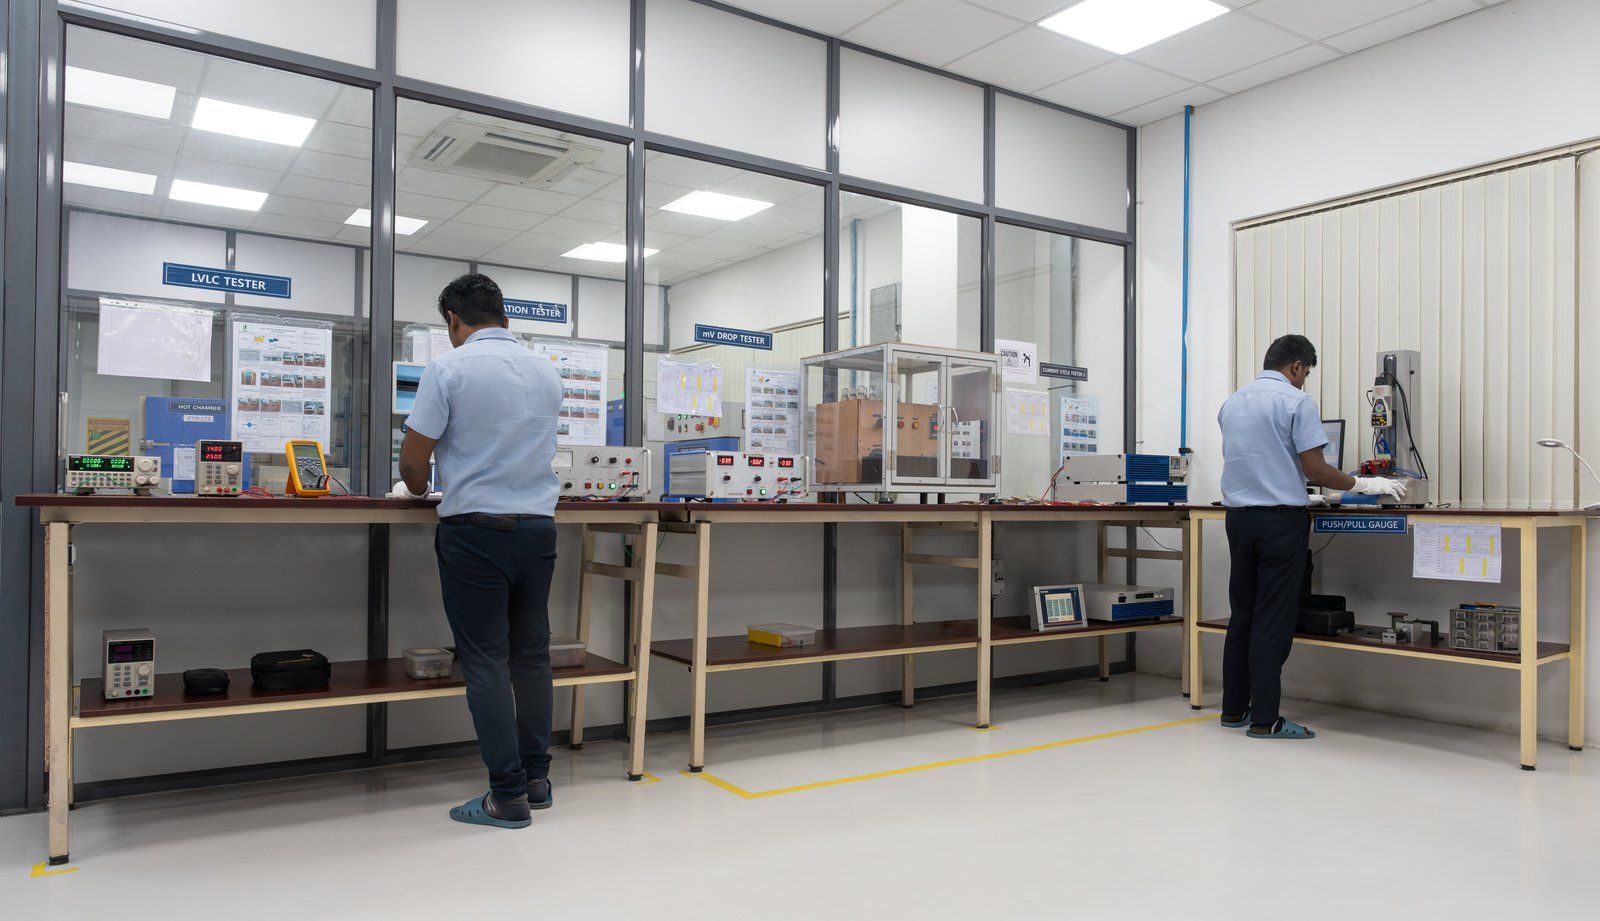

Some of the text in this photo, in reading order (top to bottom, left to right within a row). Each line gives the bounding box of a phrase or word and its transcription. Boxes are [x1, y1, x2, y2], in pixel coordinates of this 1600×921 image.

[191, 272, 266, 290] LVLC TESTER
[531, 307, 561, 318] TESTER
[702, 330, 765, 345] mV DROP TESTER
[1000, 349, 1018, 358] CAUTION
[1042, 367, 1059, 375] CURRENT
[1322, 520, 1398, 529] PUSH/PULL GAUGE
